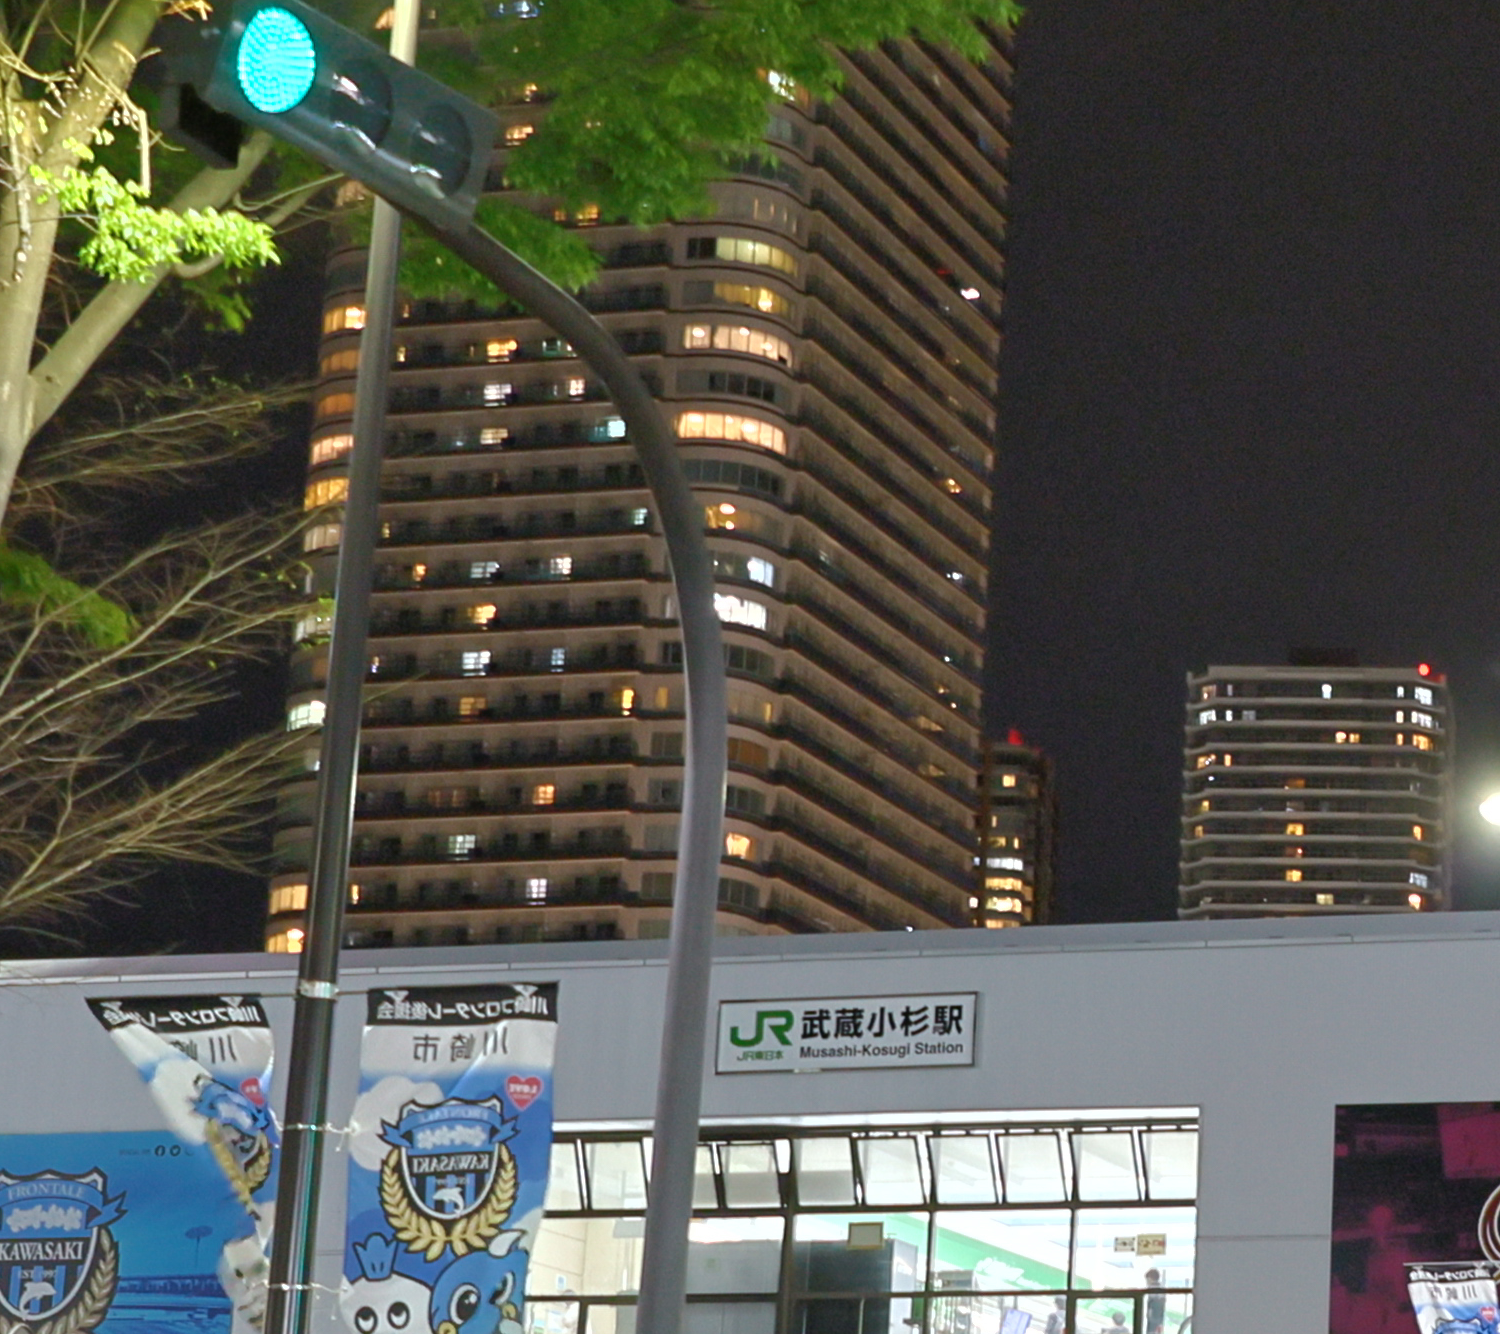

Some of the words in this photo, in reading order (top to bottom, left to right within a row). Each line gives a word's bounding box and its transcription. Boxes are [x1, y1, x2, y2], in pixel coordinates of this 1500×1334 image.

[729, 1009, 795, 1048] JR
[801, 1004, 964, 1040] 武蔵小杉駅
[736, 1049, 784, 1062] JR東日本
[799, 1044, 911, 1060] Musashi-Kosugi
[914, 1041, 964, 1055] Station
[7, 1180, 87, 1201] FRONTALE
